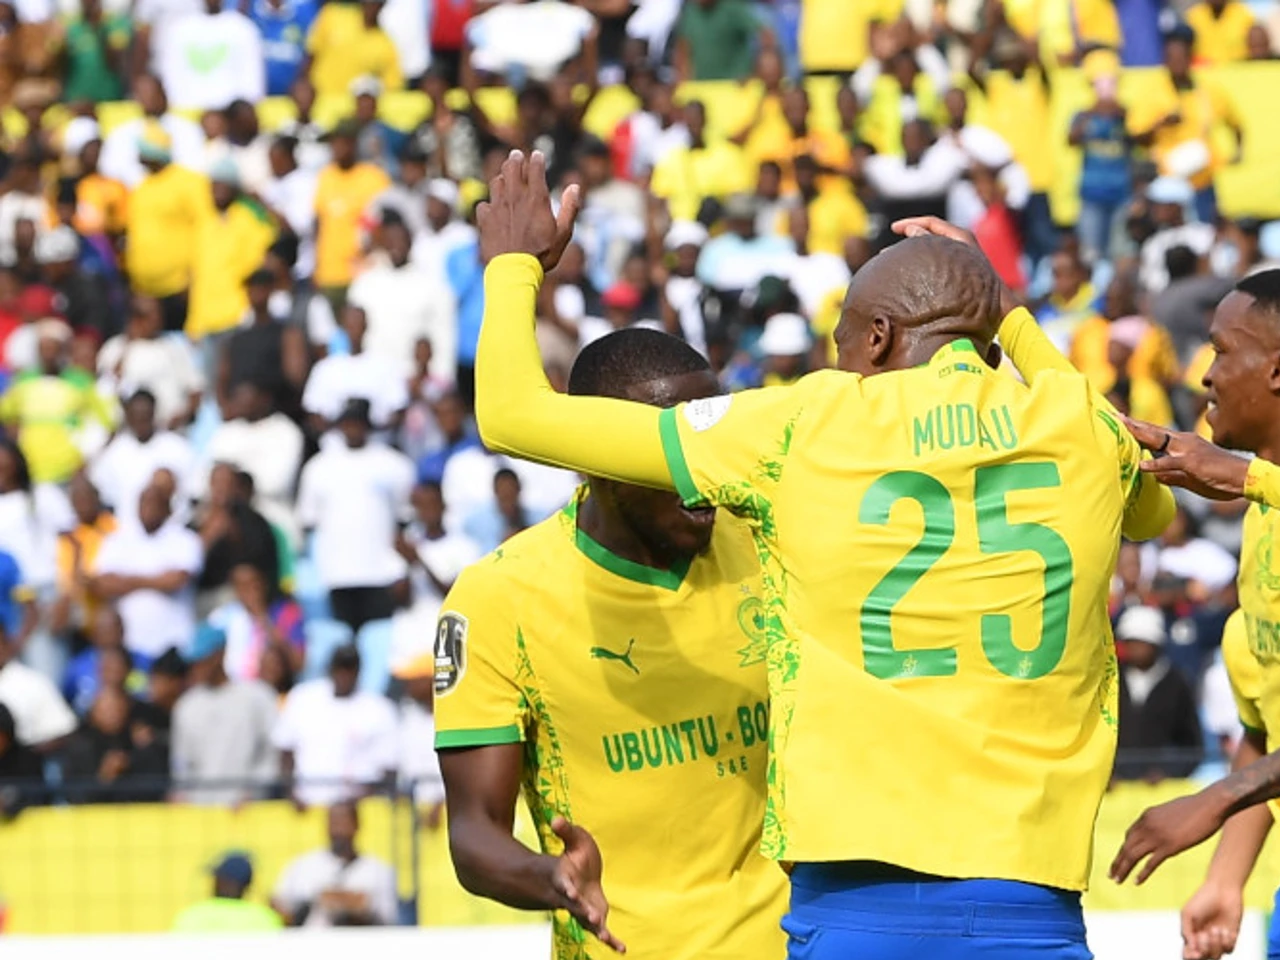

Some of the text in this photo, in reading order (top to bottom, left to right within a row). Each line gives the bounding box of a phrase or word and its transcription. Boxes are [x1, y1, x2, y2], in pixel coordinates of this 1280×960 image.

[913, 403, 1018, 457] MUDAU
[858, 461, 1074, 680] 25
[602, 714, 719, 773] UBUNTU
[737, 698, 770, 748] BO
